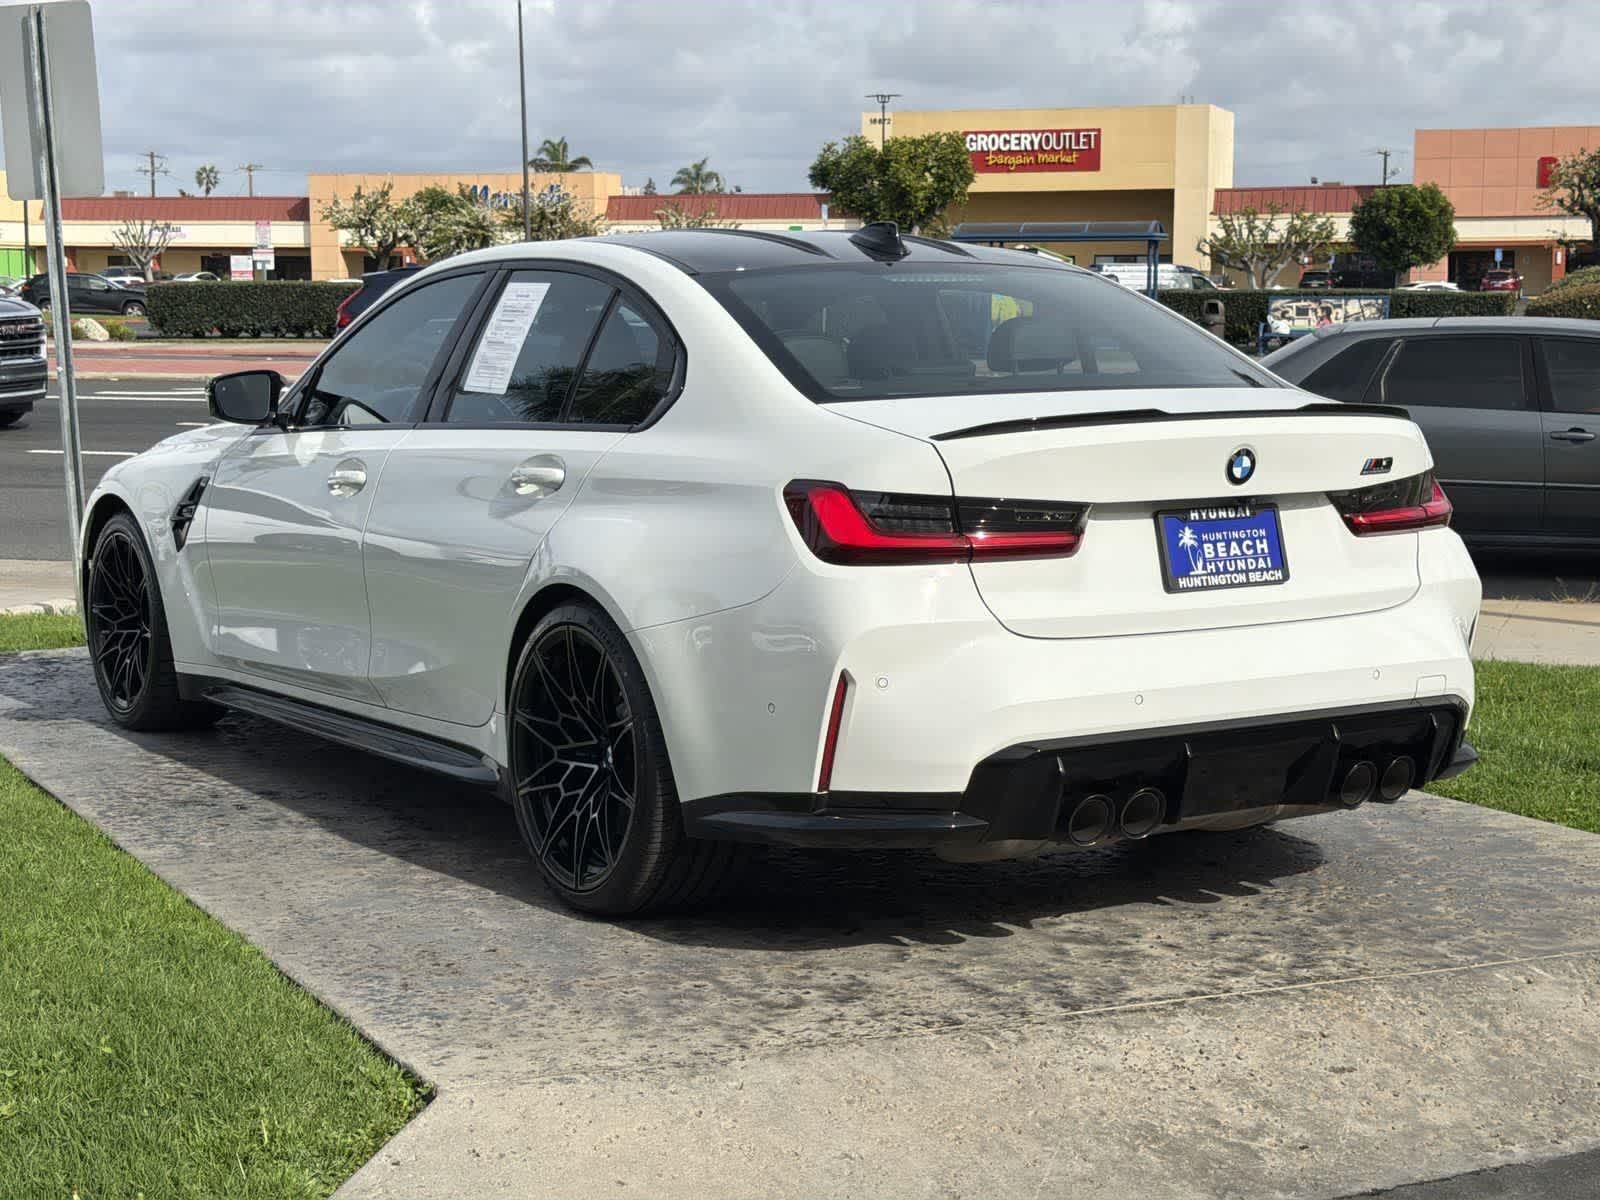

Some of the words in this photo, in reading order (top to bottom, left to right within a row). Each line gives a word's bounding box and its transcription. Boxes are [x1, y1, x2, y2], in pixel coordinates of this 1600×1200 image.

[985, 150, 1035, 170] bargain
[1190, 507, 1251, 521] HYUNDAI
[1201, 528, 1267, 541] HUNTINGTON
[1203, 538, 1269, 558] BEACH
[1206, 557, 1272, 574] HYUNDAI
[1178, 572, 1247, 588] HUNTINGTON
[1248, 569, 1283, 584] BEACH
